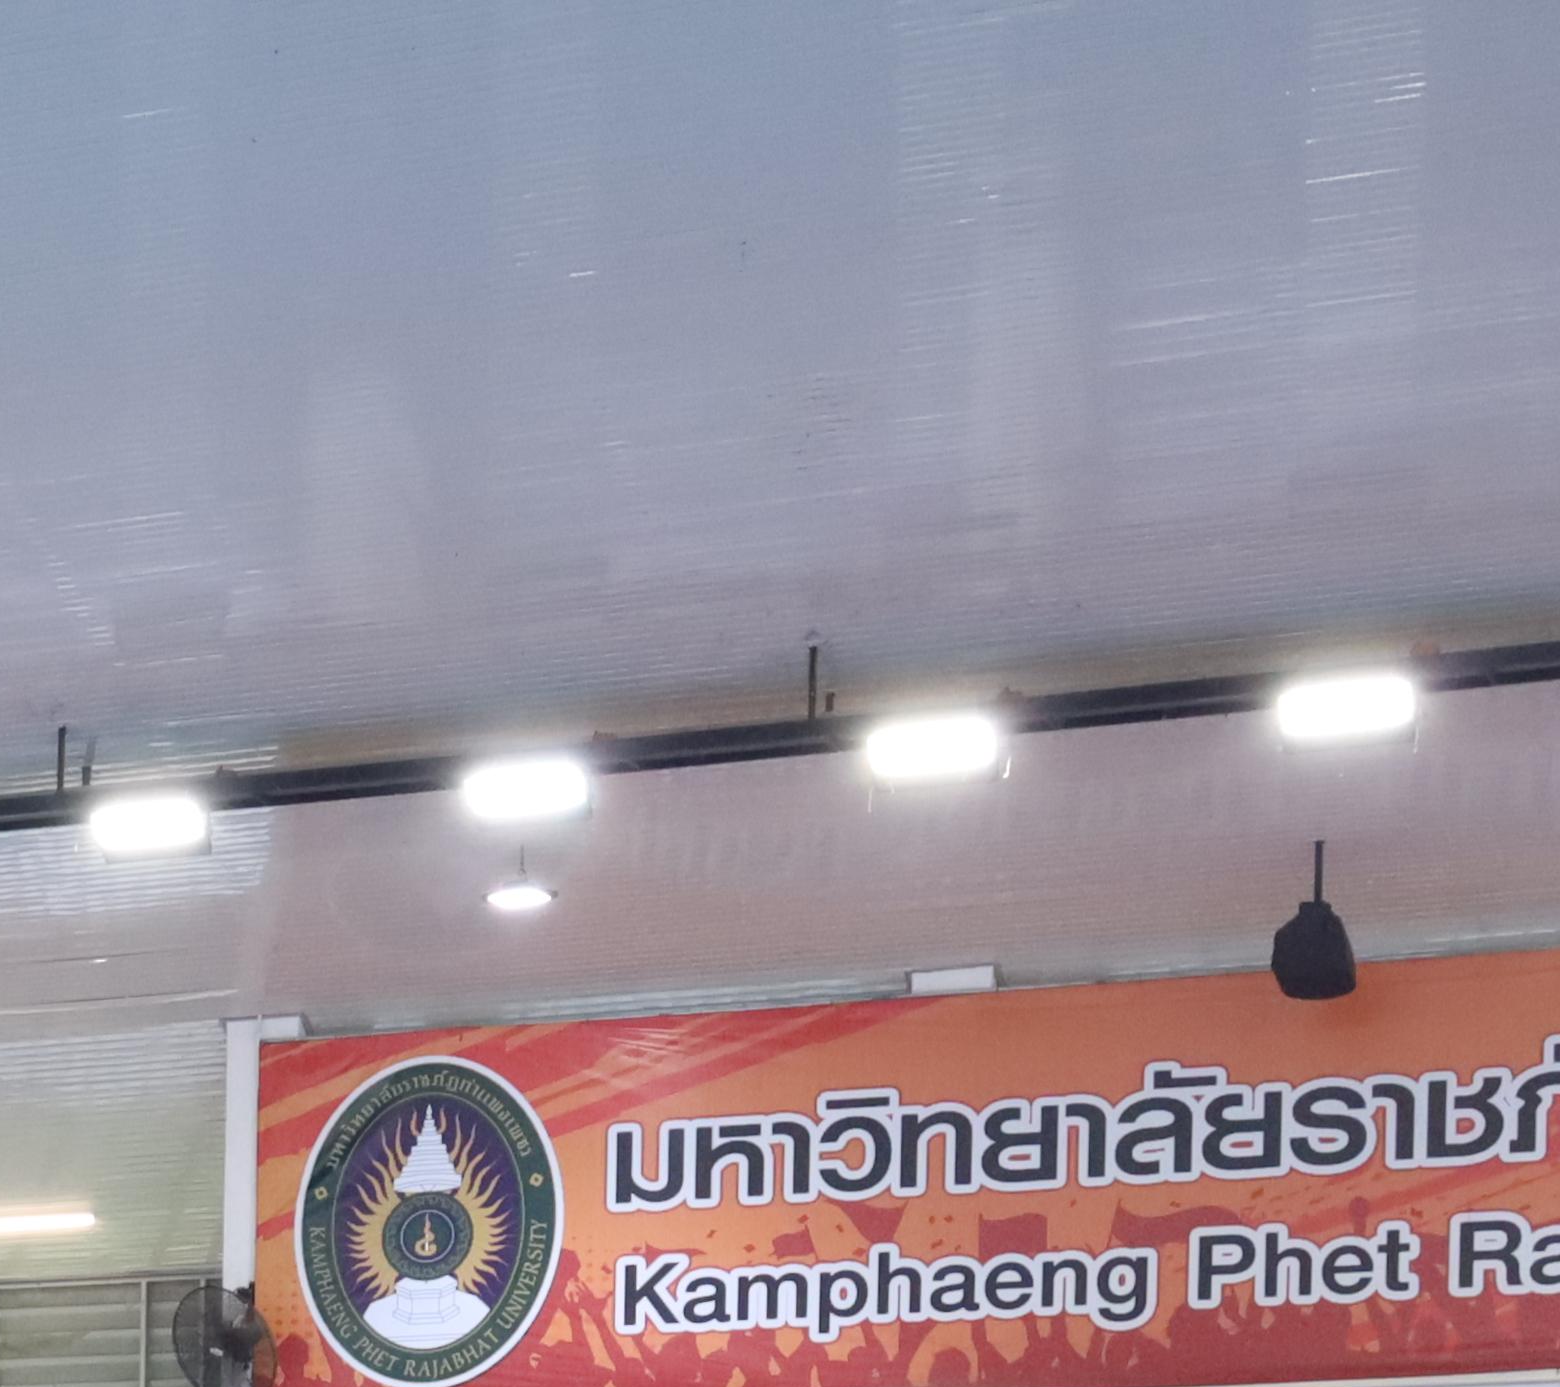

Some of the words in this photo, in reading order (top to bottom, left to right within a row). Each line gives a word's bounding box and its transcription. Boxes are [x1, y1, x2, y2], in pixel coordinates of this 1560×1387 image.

[614, 1043, 1560, 1204] มหาวิทยาลัยราชภ
[353, 1333, 397, 1372] PHET
[403, 1330, 499, 1379] RAJABHAT
[498, 1219, 548, 1330] UNIVERSITY
[621, 1251, 1150, 1333] Kamphaeng
[1196, 1229, 1412, 1301] Phet
